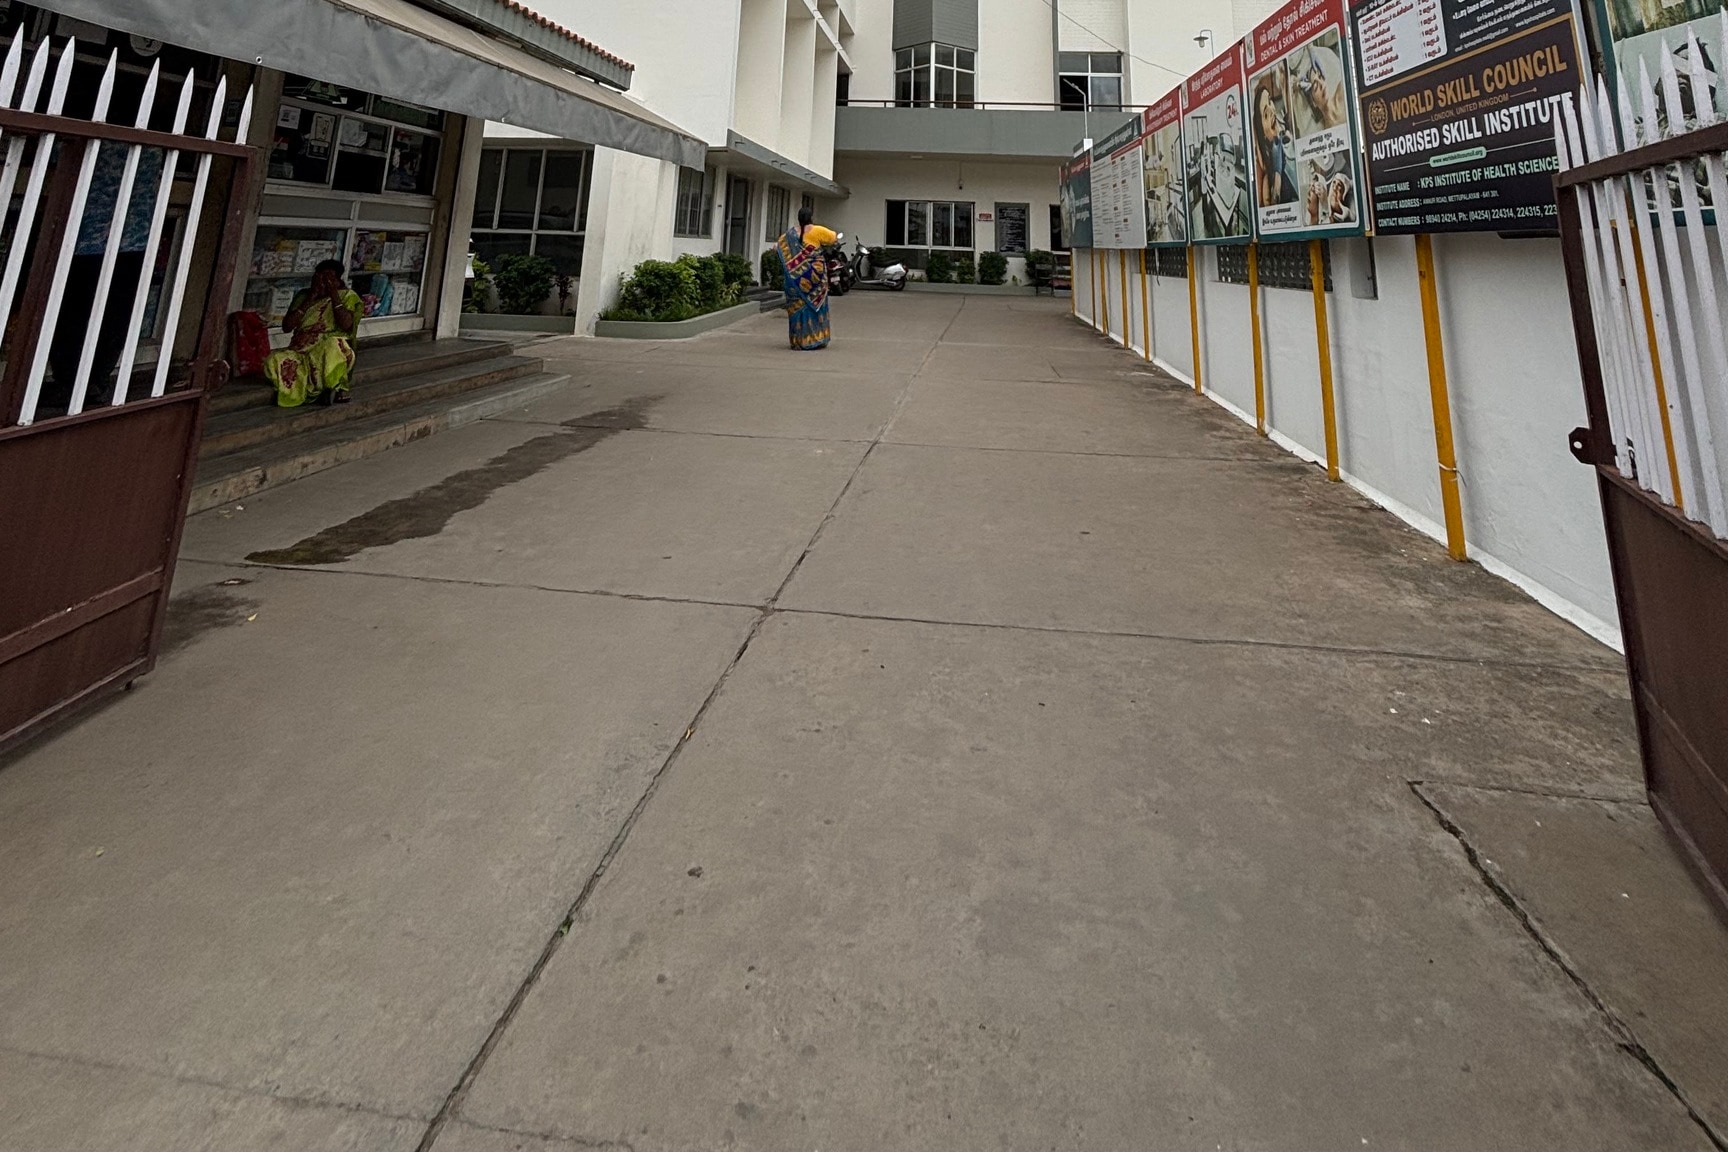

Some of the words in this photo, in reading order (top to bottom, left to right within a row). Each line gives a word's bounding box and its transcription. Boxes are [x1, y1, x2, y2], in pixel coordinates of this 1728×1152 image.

[1260, 44, 1278, 61] DENTAL
[1282, 32, 1294, 47] SKIN
[1295, 9, 1327, 38] TREATMENT
[1390, 90, 1433, 121] WORLD
[1437, 75, 1479, 107] SKILL
[1483, 44, 1567, 94] COUNCIL
[1455, 102, 1477, 114] UNITED
[1478, 93, 1508, 108] KINGDOM
[1372, 128, 1439, 160] AUTHORISED
[1442, 117, 1481, 144] SKILL
[1396, 181, 1410, 191] NAME
[1420, 176, 1433, 188] KPS
[1434, 170, 1470, 186] INSTITUTE
[1471, 168, 1481, 181] OF
[1483, 163, 1516, 179] HEALTH
[1518, 155, 1559, 174] SCIENCE
[1468, 209, 1491, 222] (04254)
[1491, 208, 1516, 218] 224314,
[1516, 205, 1543, 217] 224315,
[1543, 204, 1557, 215] 223
